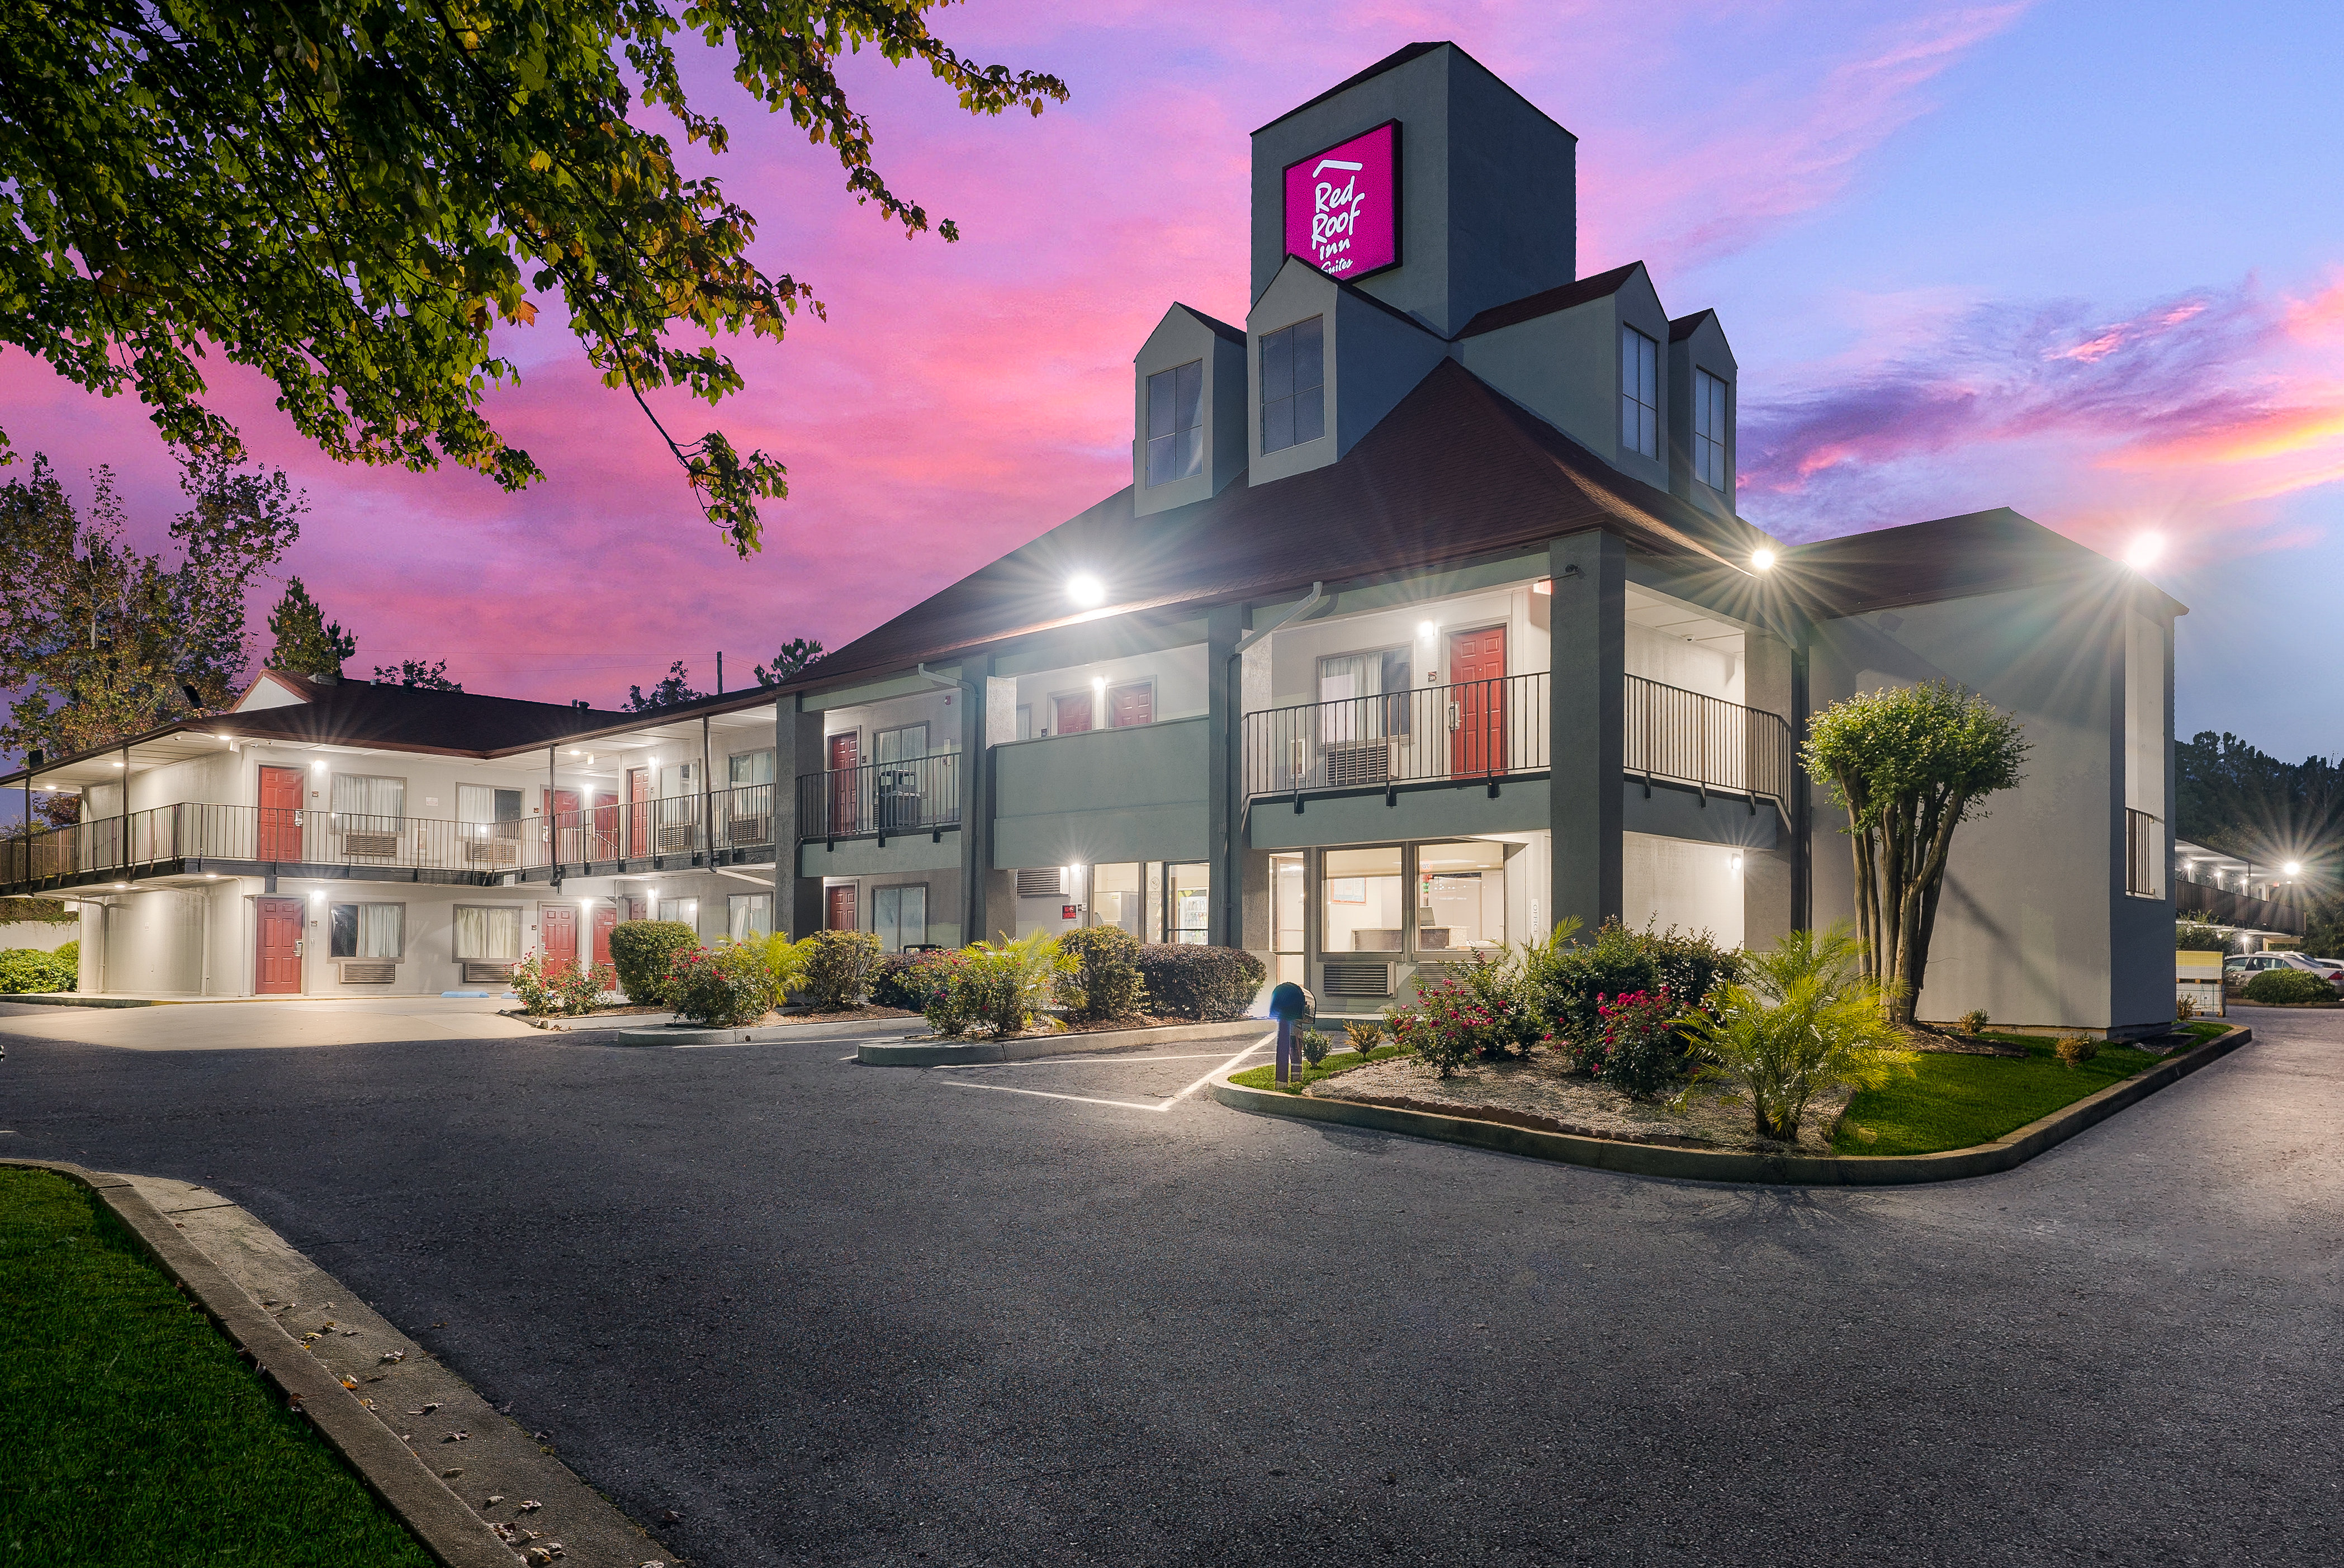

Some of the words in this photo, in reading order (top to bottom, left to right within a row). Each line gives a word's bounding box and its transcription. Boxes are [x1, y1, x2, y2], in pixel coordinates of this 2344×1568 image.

[1315, 176, 1355, 213] Red
[1312, 193, 1365, 250] Roof
[1321, 258, 1353, 274] Suites
